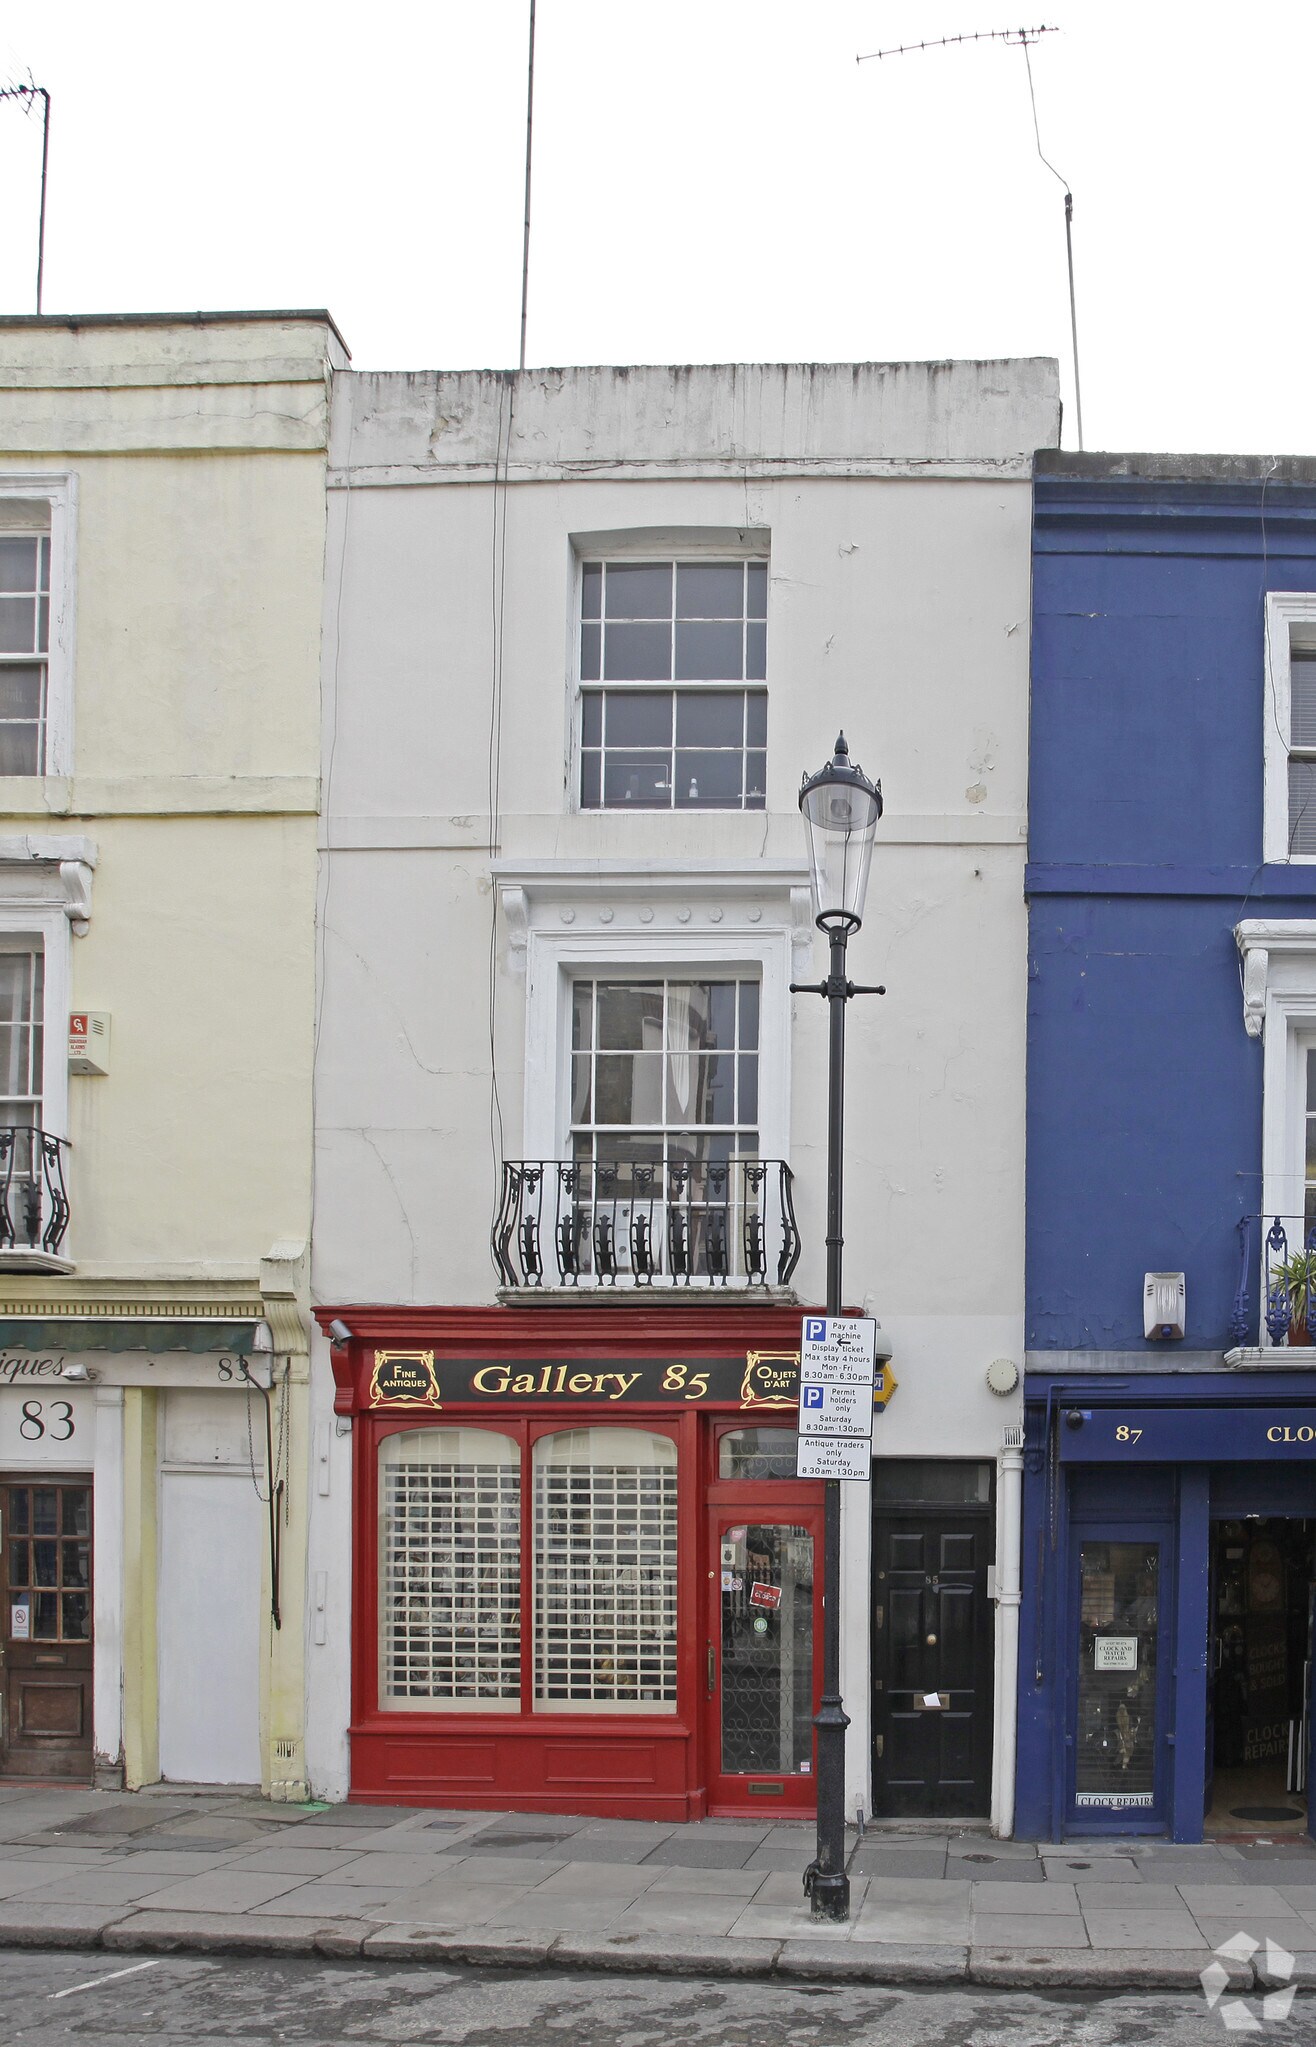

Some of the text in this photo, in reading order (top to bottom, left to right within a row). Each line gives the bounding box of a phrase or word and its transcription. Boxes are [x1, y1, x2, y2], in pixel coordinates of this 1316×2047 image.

[832, 1322, 858, 1331] Pay at
[830, 1332, 862, 1340] machine
[811, 1343, 864, 1353] Display ticket
[804, 1353, 821, 1361] Max
[823, 1355, 840, 1363] stay
[848, 1355, 871, 1363] hours
[218, 1357, 249, 1382] 83
[821, 1363, 838, 1371] Mon
[843, 1364, 853, 1372] Fri
[382, 1380, 427, 1388] ANTIQUES
[472, 1364, 711, 1400] Gallery 85
[763, 1380, 790, 1389] D'ART
[832, 1388, 856, 1396] Permit
[830, 1396, 857, 1404] holders
[835, 1405, 851, 1413] only
[20, 1400, 75, 1441] 83
[819, 1414, 852, 1424] Saturday
[1115, 1425, 1143, 1445] 87
[1266, 1426, 1316, 1442] CLO
[804, 1439, 865, 1449] Antique traders
[825, 1449, 842, 1457] only
[816, 1457, 851, 1467] Saturday
[925, 1575, 939, 1585] 85
[1081, 1797, 1115, 1806] CLOCK
